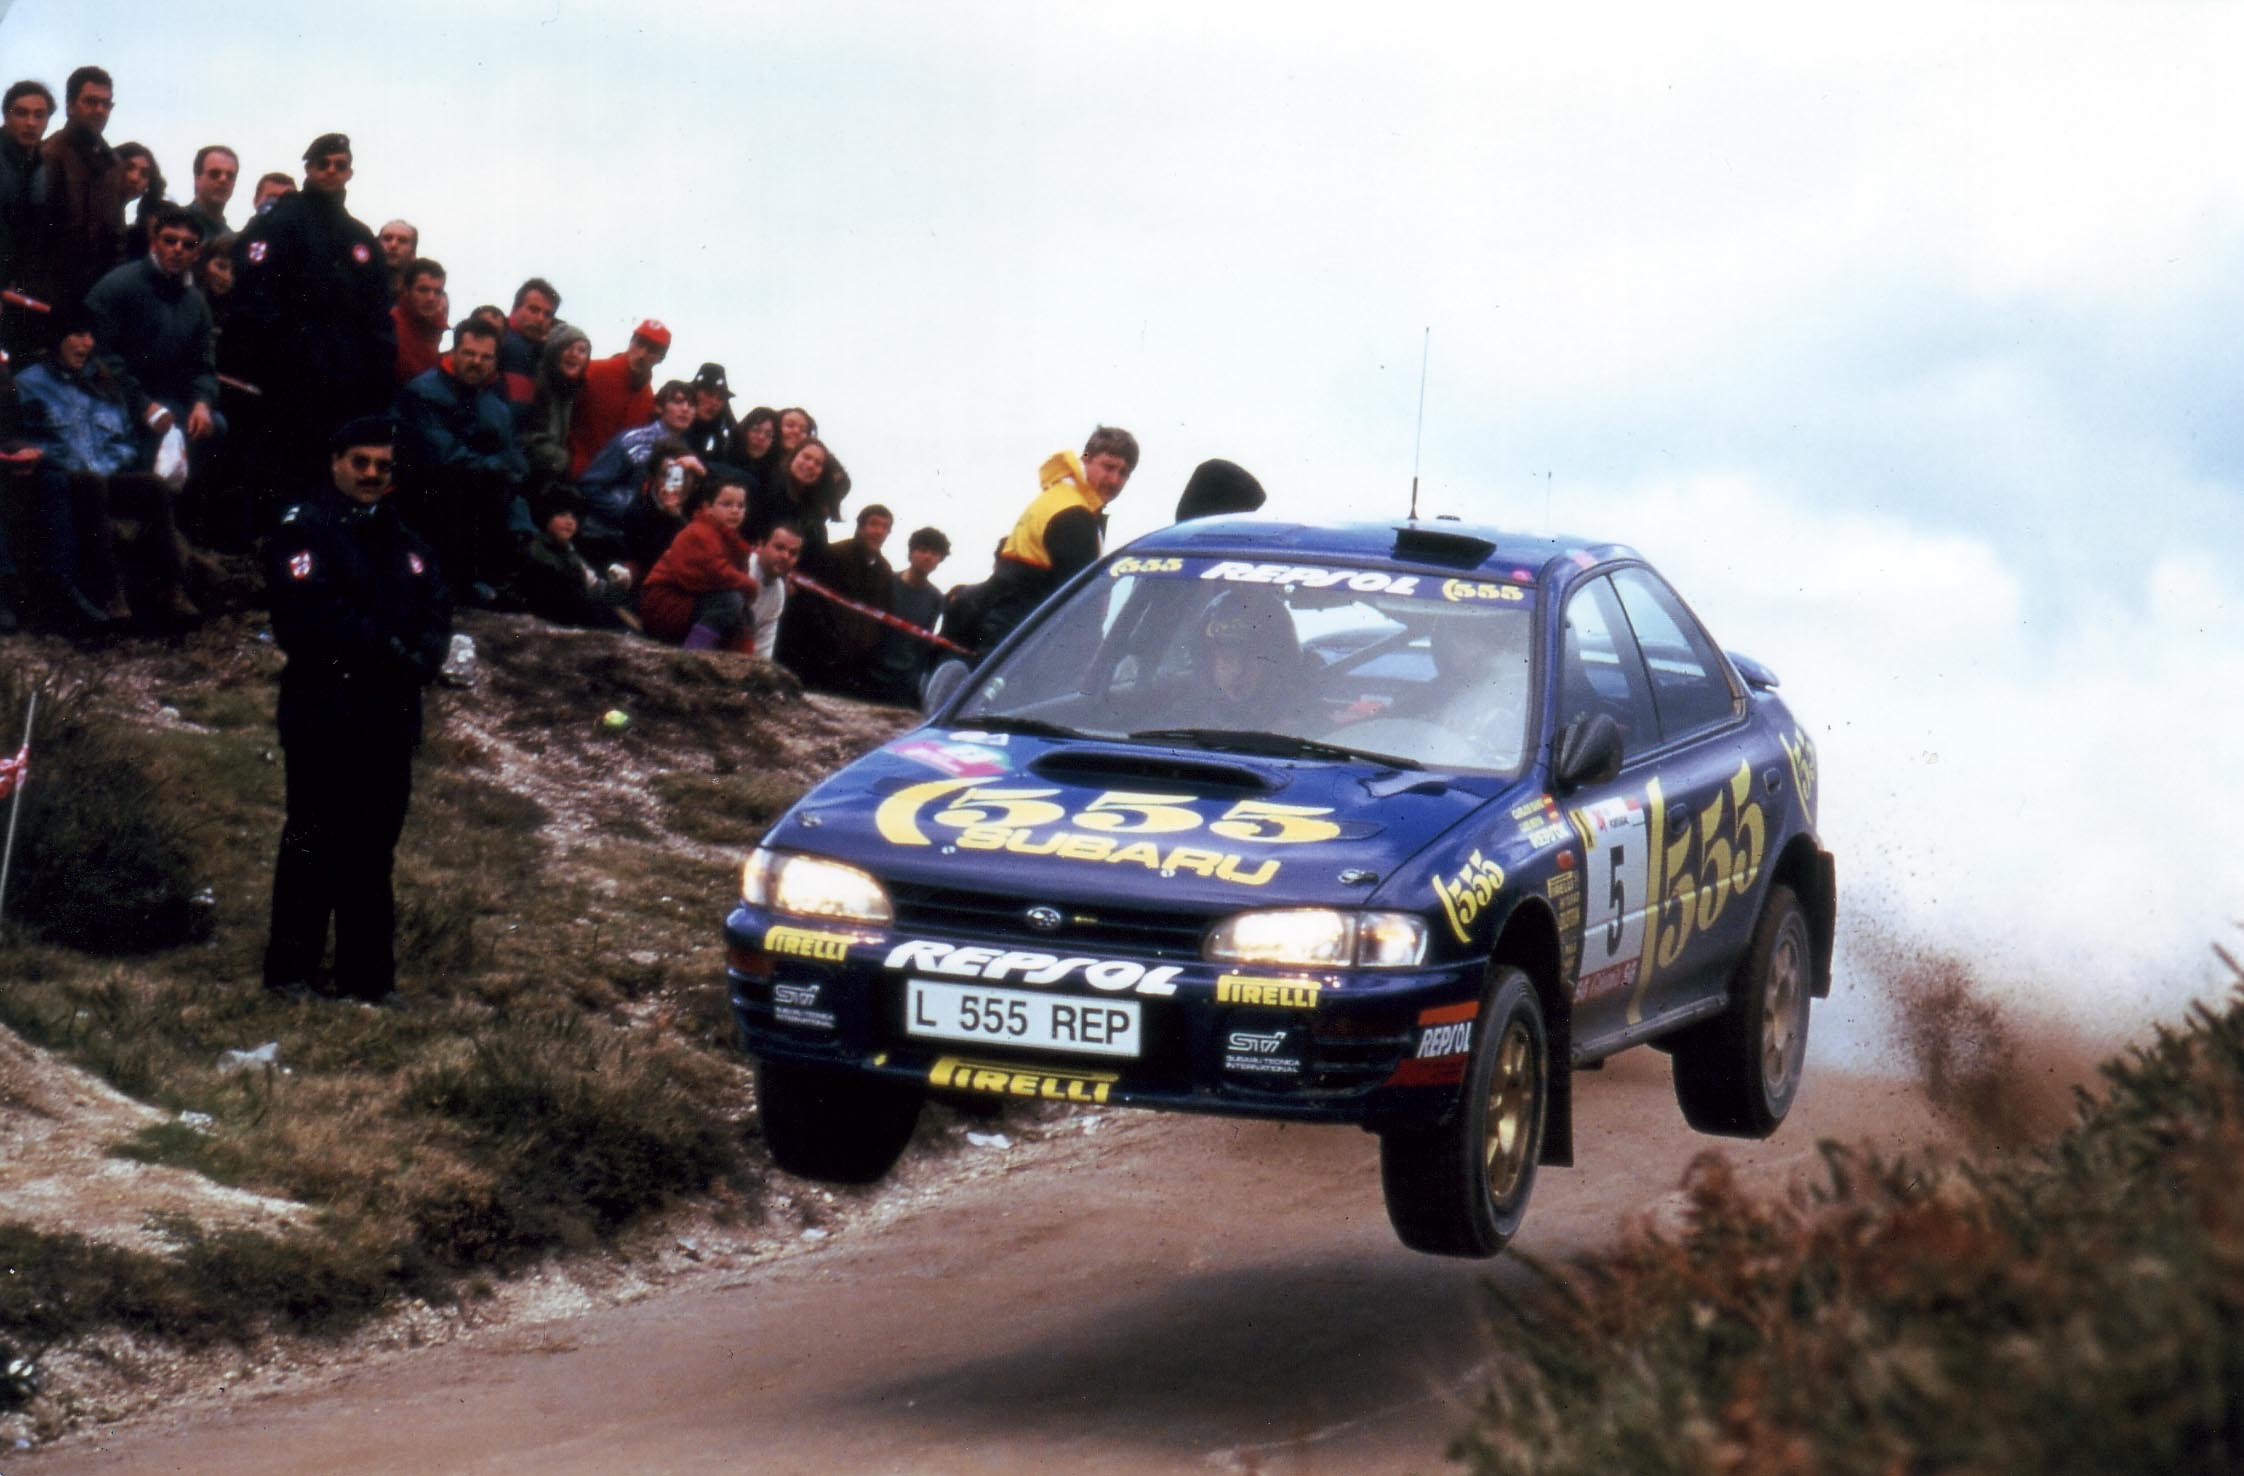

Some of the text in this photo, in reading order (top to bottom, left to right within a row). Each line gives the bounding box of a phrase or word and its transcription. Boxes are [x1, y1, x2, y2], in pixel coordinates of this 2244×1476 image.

[1201, 561, 1420, 596] REPSOL
[955, 827, 1281, 886] SUBARU
[1606, 845, 1625, 957] 5
[764, 926, 850, 961] PIRELLI
[884, 940, 1184, 996] REPSOL
[1217, 974, 1322, 1008] PIRELLI
[916, 990, 1131, 1045] L 555 REP
[1416, 1021, 1473, 1059] REPSOL
[929, 1056, 1120, 1103] PIRELLI
